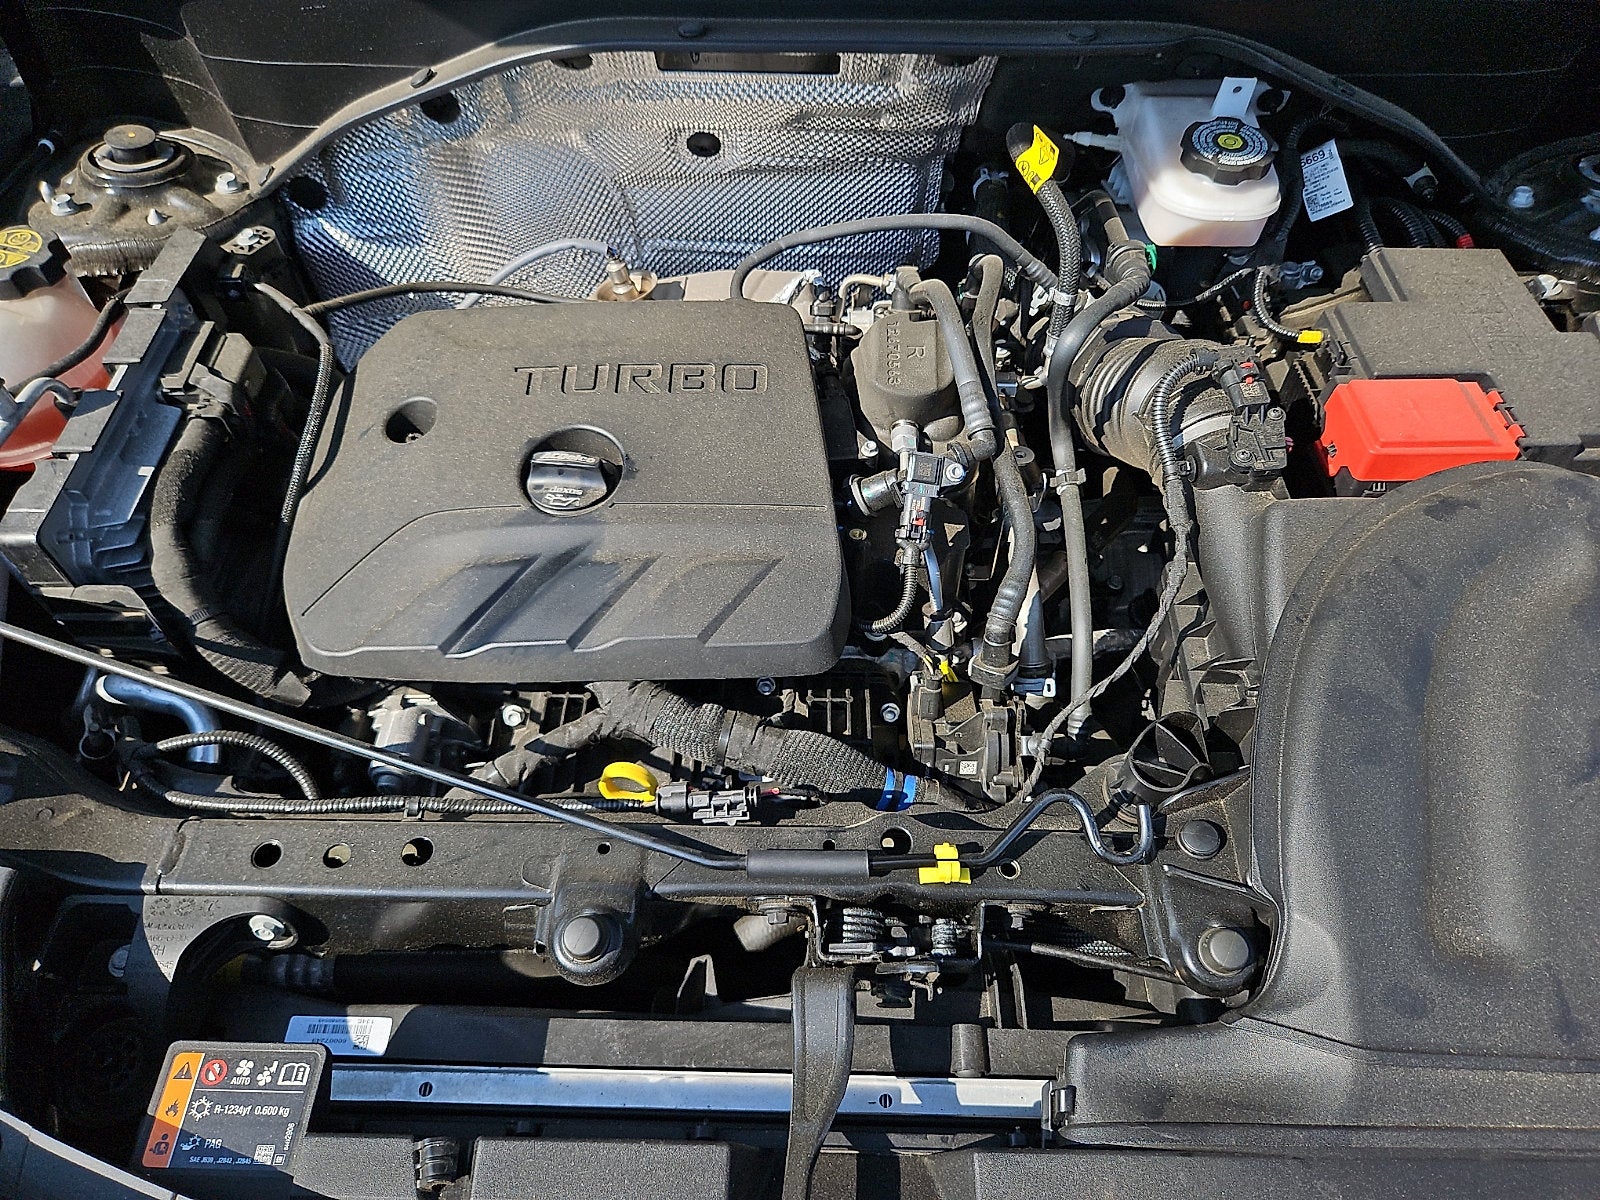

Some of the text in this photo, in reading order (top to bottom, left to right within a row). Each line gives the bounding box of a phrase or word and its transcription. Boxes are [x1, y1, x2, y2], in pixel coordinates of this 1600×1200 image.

[906, 345, 926, 360] R
[514, 363, 768, 395] TURBO
[549, 486, 584, 496] dexos
[230, 1076, 251, 1086] AUTO
[213, 1104, 290, 1118] R-1234yf 0.600 kg
[204, 1138, 223, 1149] PAG
